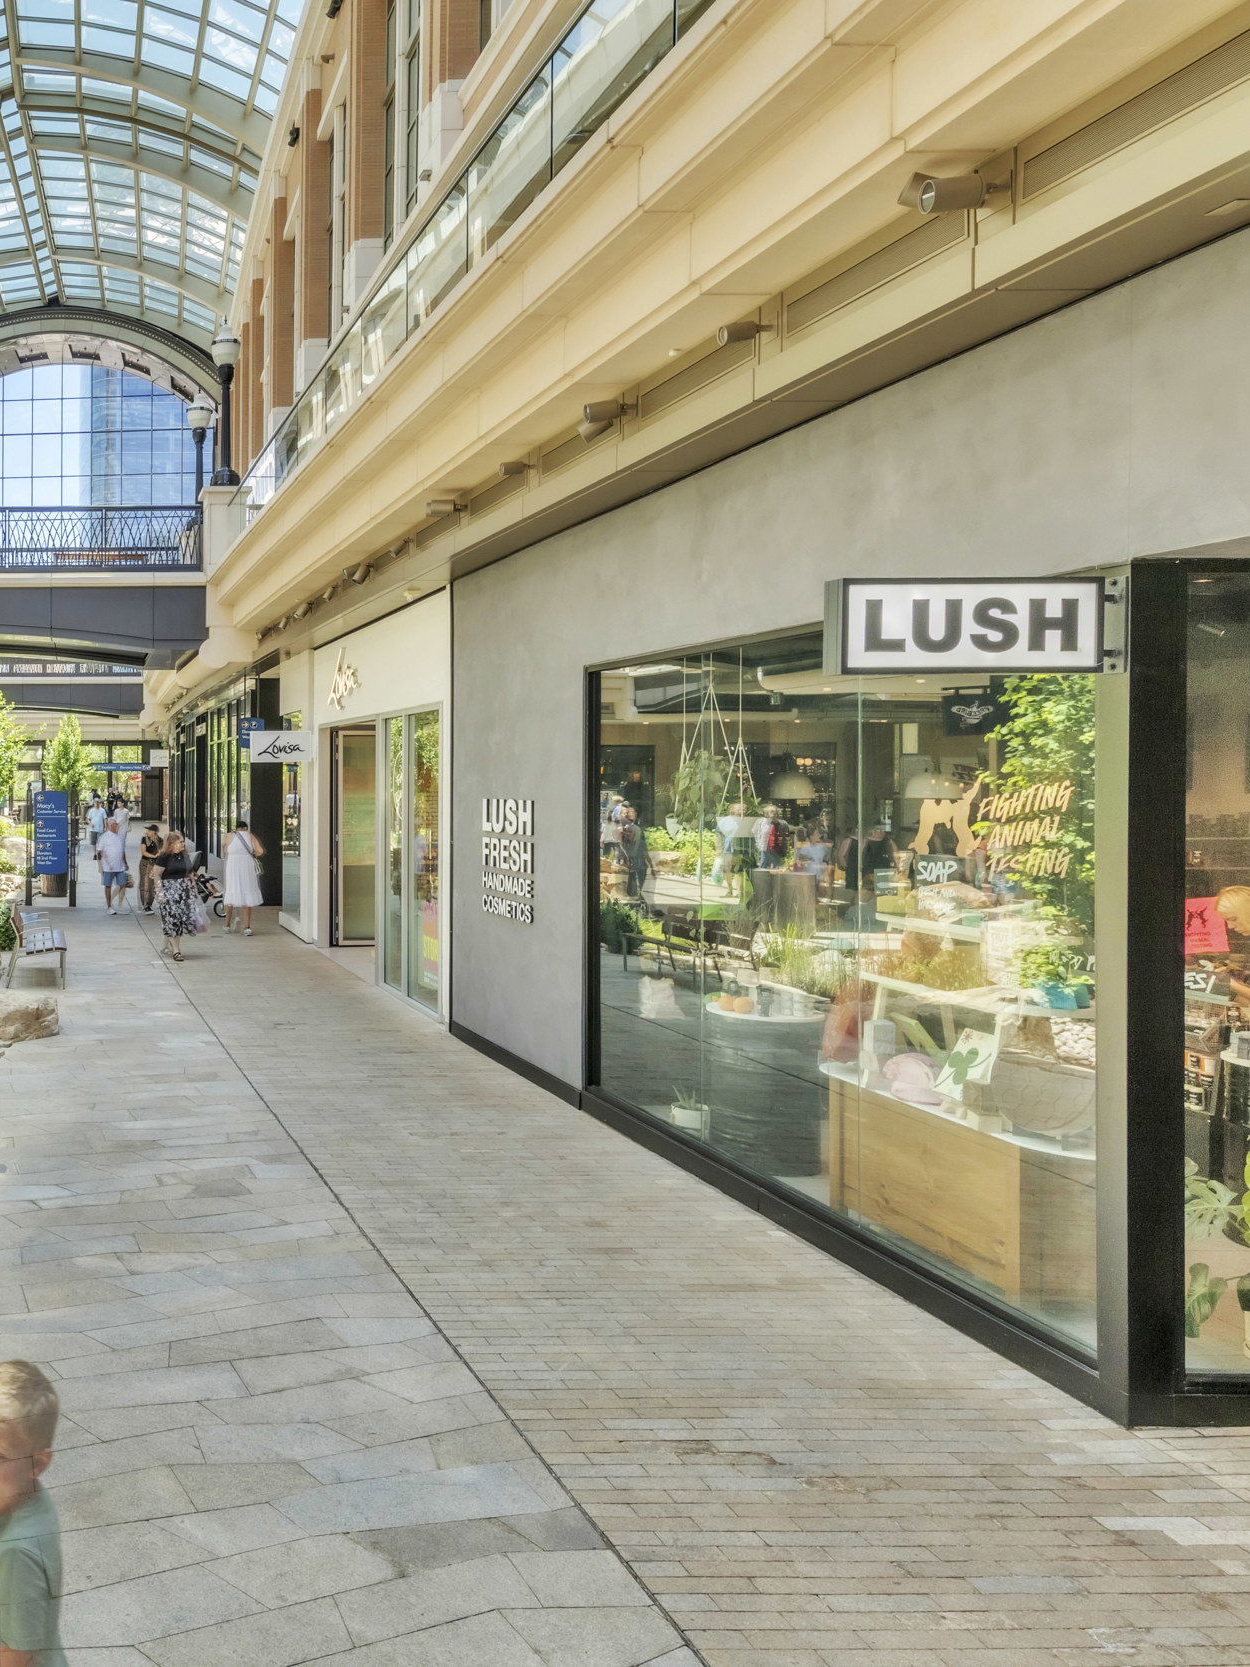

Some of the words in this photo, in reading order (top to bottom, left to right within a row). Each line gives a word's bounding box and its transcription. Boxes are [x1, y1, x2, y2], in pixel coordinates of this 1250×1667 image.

[864, 597, 1079, 653] LUSH
[258, 735, 306, 759] Lovisa
[482, 799, 532, 835] LUSH
[977, 780, 1075, 822] FIGHTING
[987, 816, 1064, 849] ANIMAL
[482, 837, 532, 874] FRESH
[917, 860, 958, 884] SOAP
[482, 871, 532, 898] HANDMADE
[482, 894, 533, 924] COSMETICS
